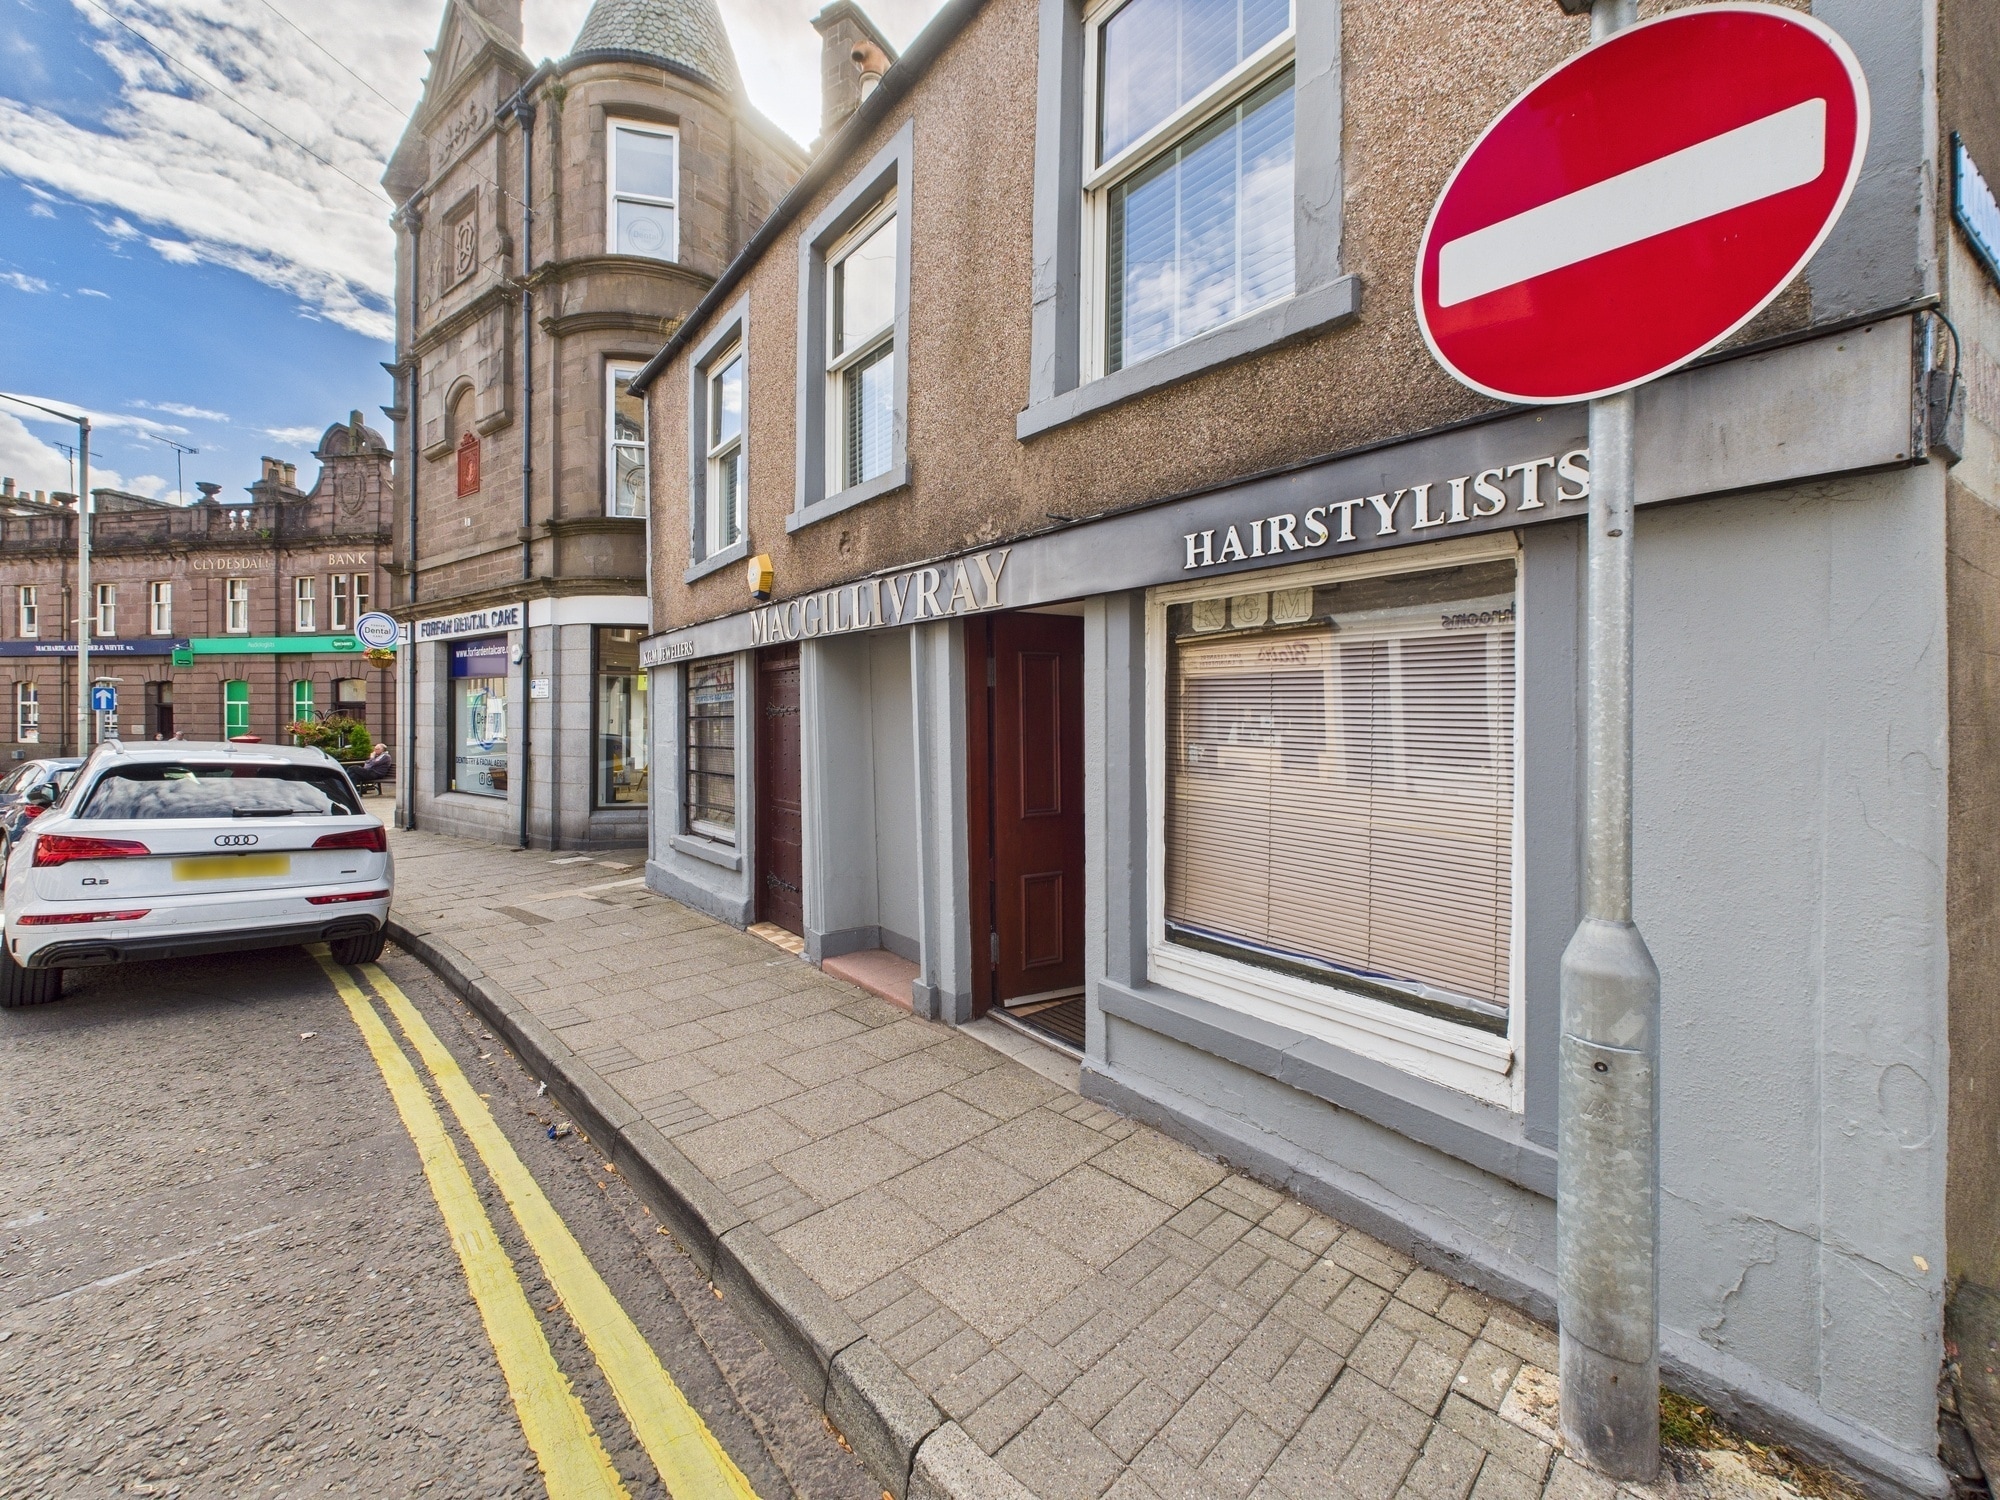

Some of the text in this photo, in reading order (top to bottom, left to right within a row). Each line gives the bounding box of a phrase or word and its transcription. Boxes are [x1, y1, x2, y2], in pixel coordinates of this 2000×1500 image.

[1183, 448, 1589, 570] HAIRSTYLISTS
[328, 552, 367, 566] BANK
[749, 548, 1013, 647] MACGILLIVRAY
[364, 626, 391, 635] Dental
[421, 607, 519, 638] FORFAR DENTAL CARE
[658, 640, 693, 662] JEWELLERS
